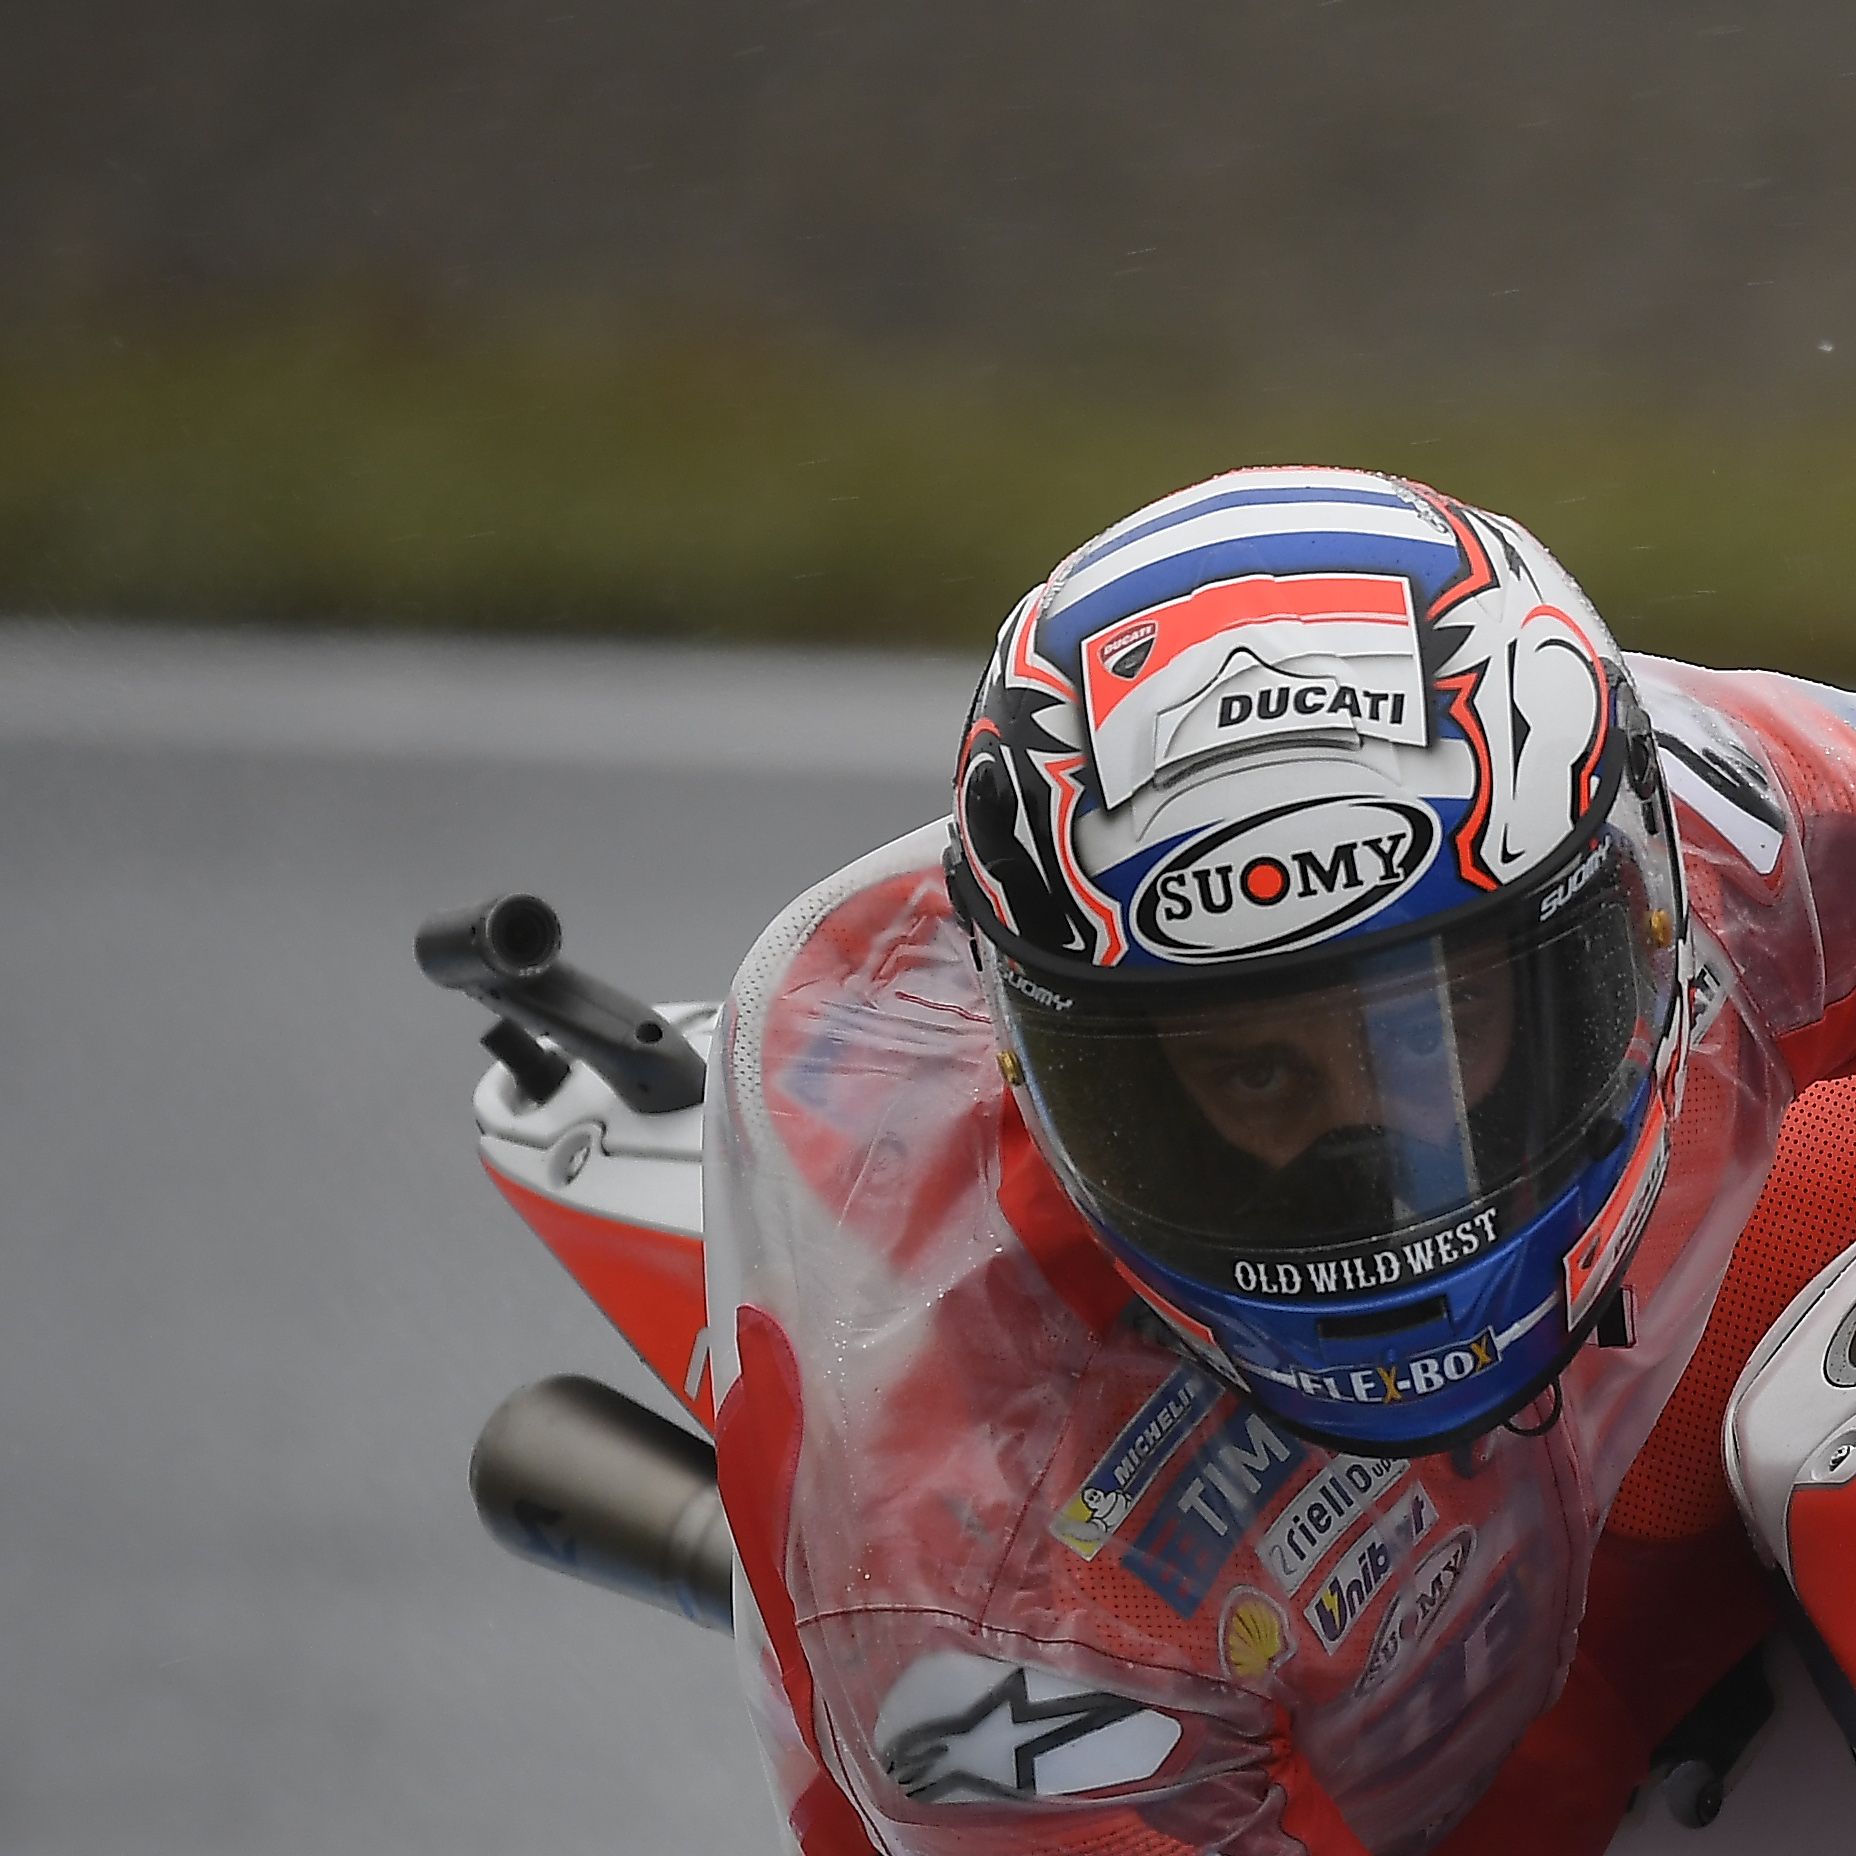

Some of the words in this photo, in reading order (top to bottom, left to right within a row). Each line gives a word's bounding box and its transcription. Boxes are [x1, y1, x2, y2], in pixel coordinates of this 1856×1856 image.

[1104, 626, 1153, 655] DUCATI
[1217, 685, 1406, 729] DUCATI
[1159, 832, 1408, 922] SUOMY
[1539, 835, 1613, 922] SUOMY
[1234, 1260, 1302, 1295] OLD
[1307, 1250, 1401, 1294] WILD
[1402, 1207, 1498, 1276] WEST
[1299, 1336, 1491, 1404] FLEX-BOX
[1177, 1412, 1290, 1537] TIM
[1314, 1495, 1426, 1641] Unibt
